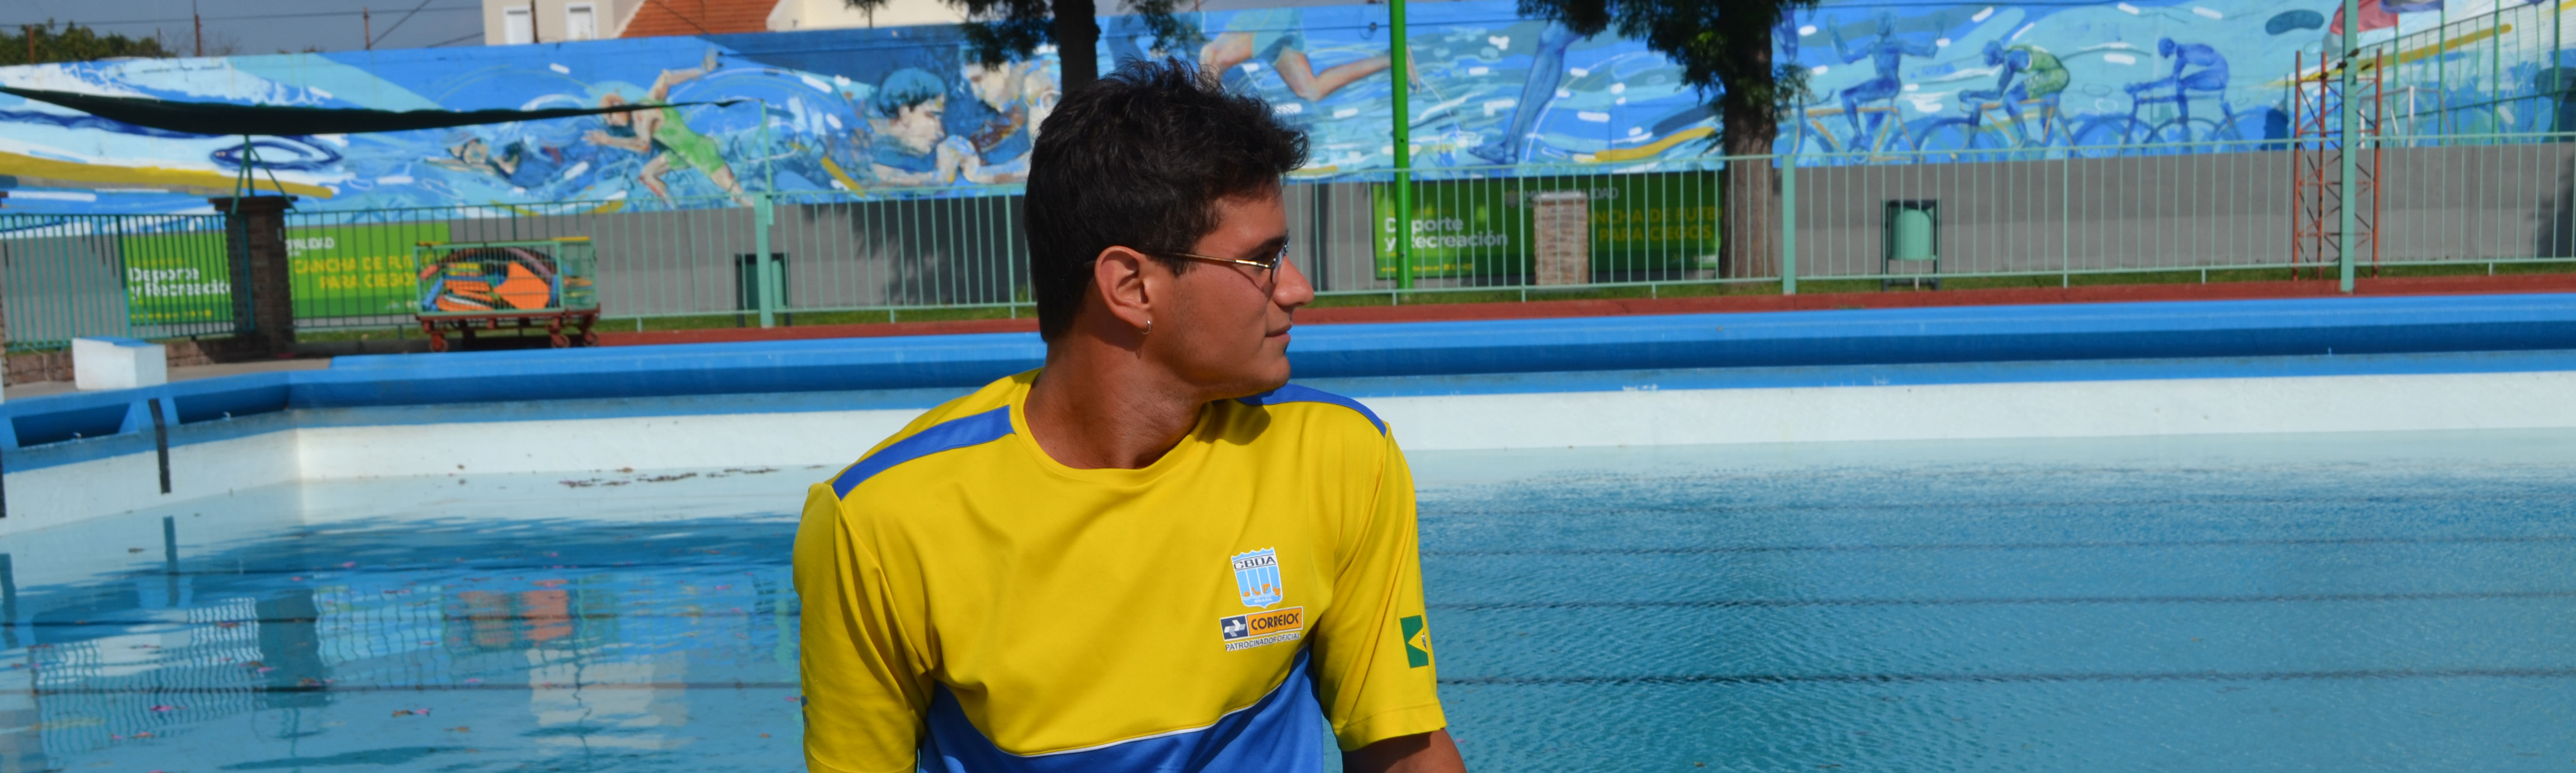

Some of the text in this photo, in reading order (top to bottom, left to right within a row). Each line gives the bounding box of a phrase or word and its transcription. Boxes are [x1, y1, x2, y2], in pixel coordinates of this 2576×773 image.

[1384, 216, 1464, 234] Dporte
[1588, 209, 1644, 223] ANCHA
[1384, 230, 1508, 252] y ecreación
[294, 258, 358, 274] CANCHA
[363, 256, 383, 271] DE
[129, 267, 200, 285] Deporte
[320, 274, 361, 289] PARA
[130, 285, 142, 301] y
[1233, 556, 1276, 570] CBDA
[1251, 612, 1299, 630] CORREIOS
[1225, 632, 1301, 652] PATROCINADOR OFICIAL
